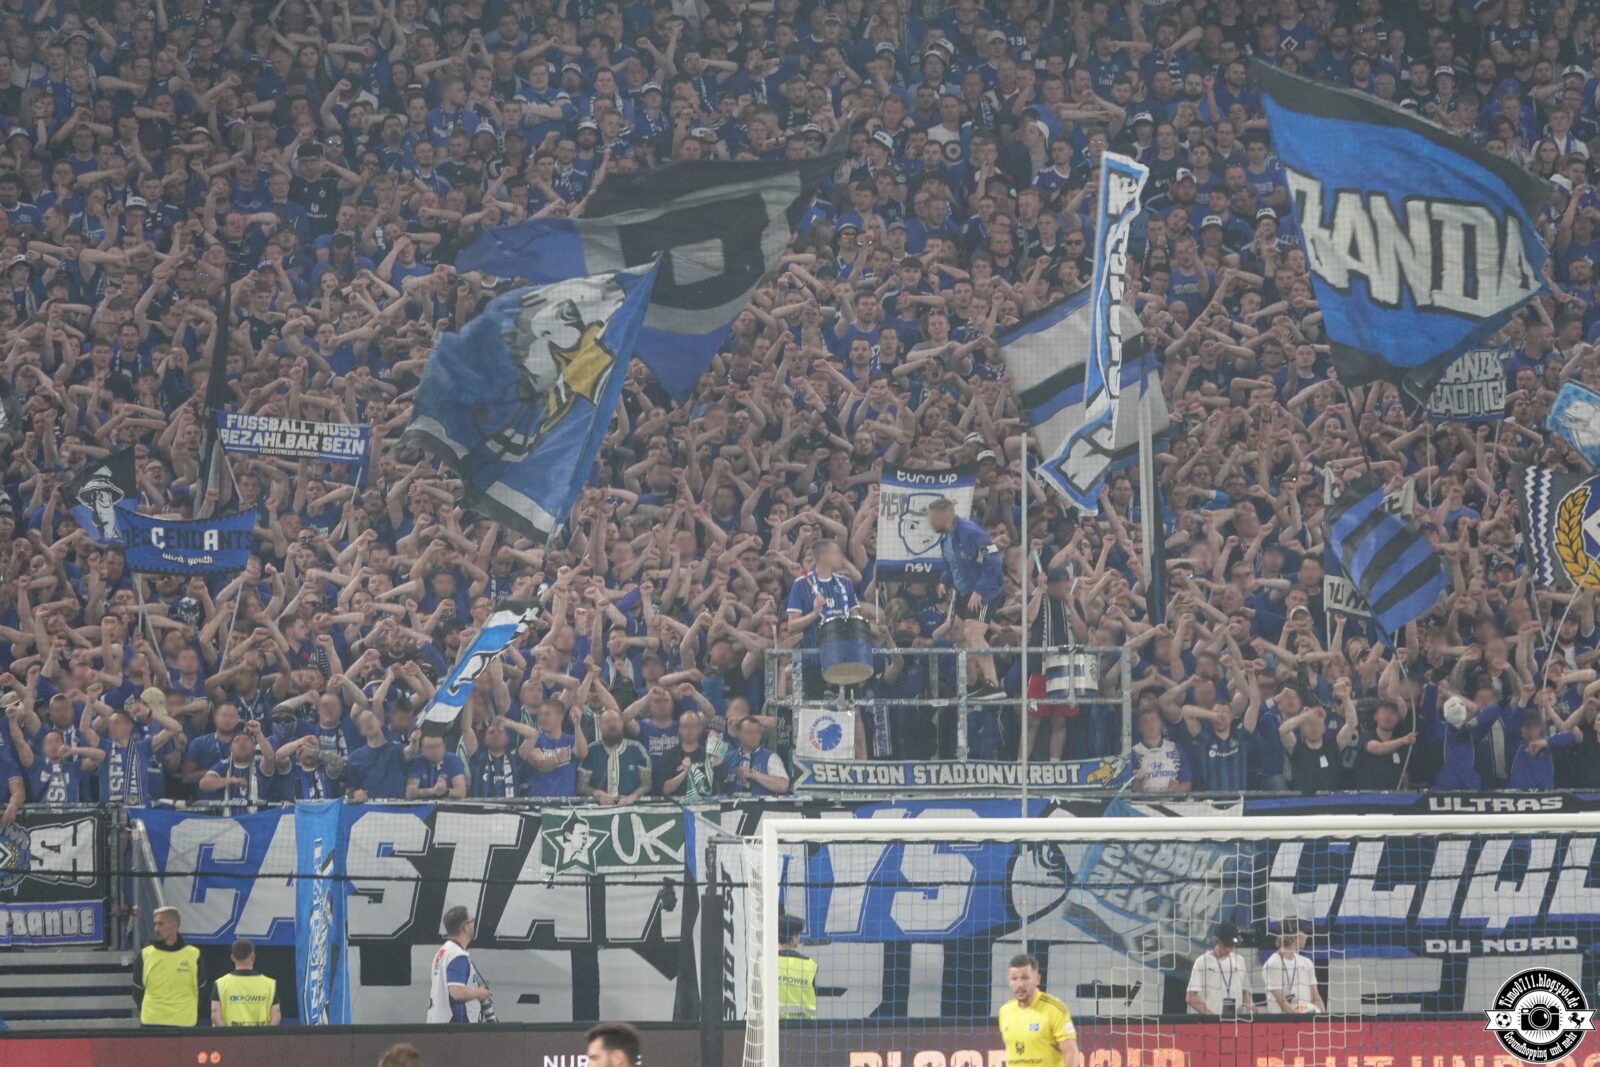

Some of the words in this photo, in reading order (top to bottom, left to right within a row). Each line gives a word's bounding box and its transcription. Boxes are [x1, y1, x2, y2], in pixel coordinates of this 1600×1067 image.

[226, 414, 310, 434] FUSSBALL
[313, 421, 361, 438] MUSS
[220, 428, 318, 450] BEZAHLBAR
[322, 438, 365, 455] SEIN
[939, 472, 958, 485] up
[812, 762, 905, 785] SEKTION
[913, 762, 1081, 786] STADIONVERBOT
[1428, 796, 1563, 813] ULTRAS
[611, 812, 692, 865] UK
[158, 807, 977, 942] CASTAYS
[1425, 938, 1470, 953] DU
[1483, 936, 1578, 953] NORD
